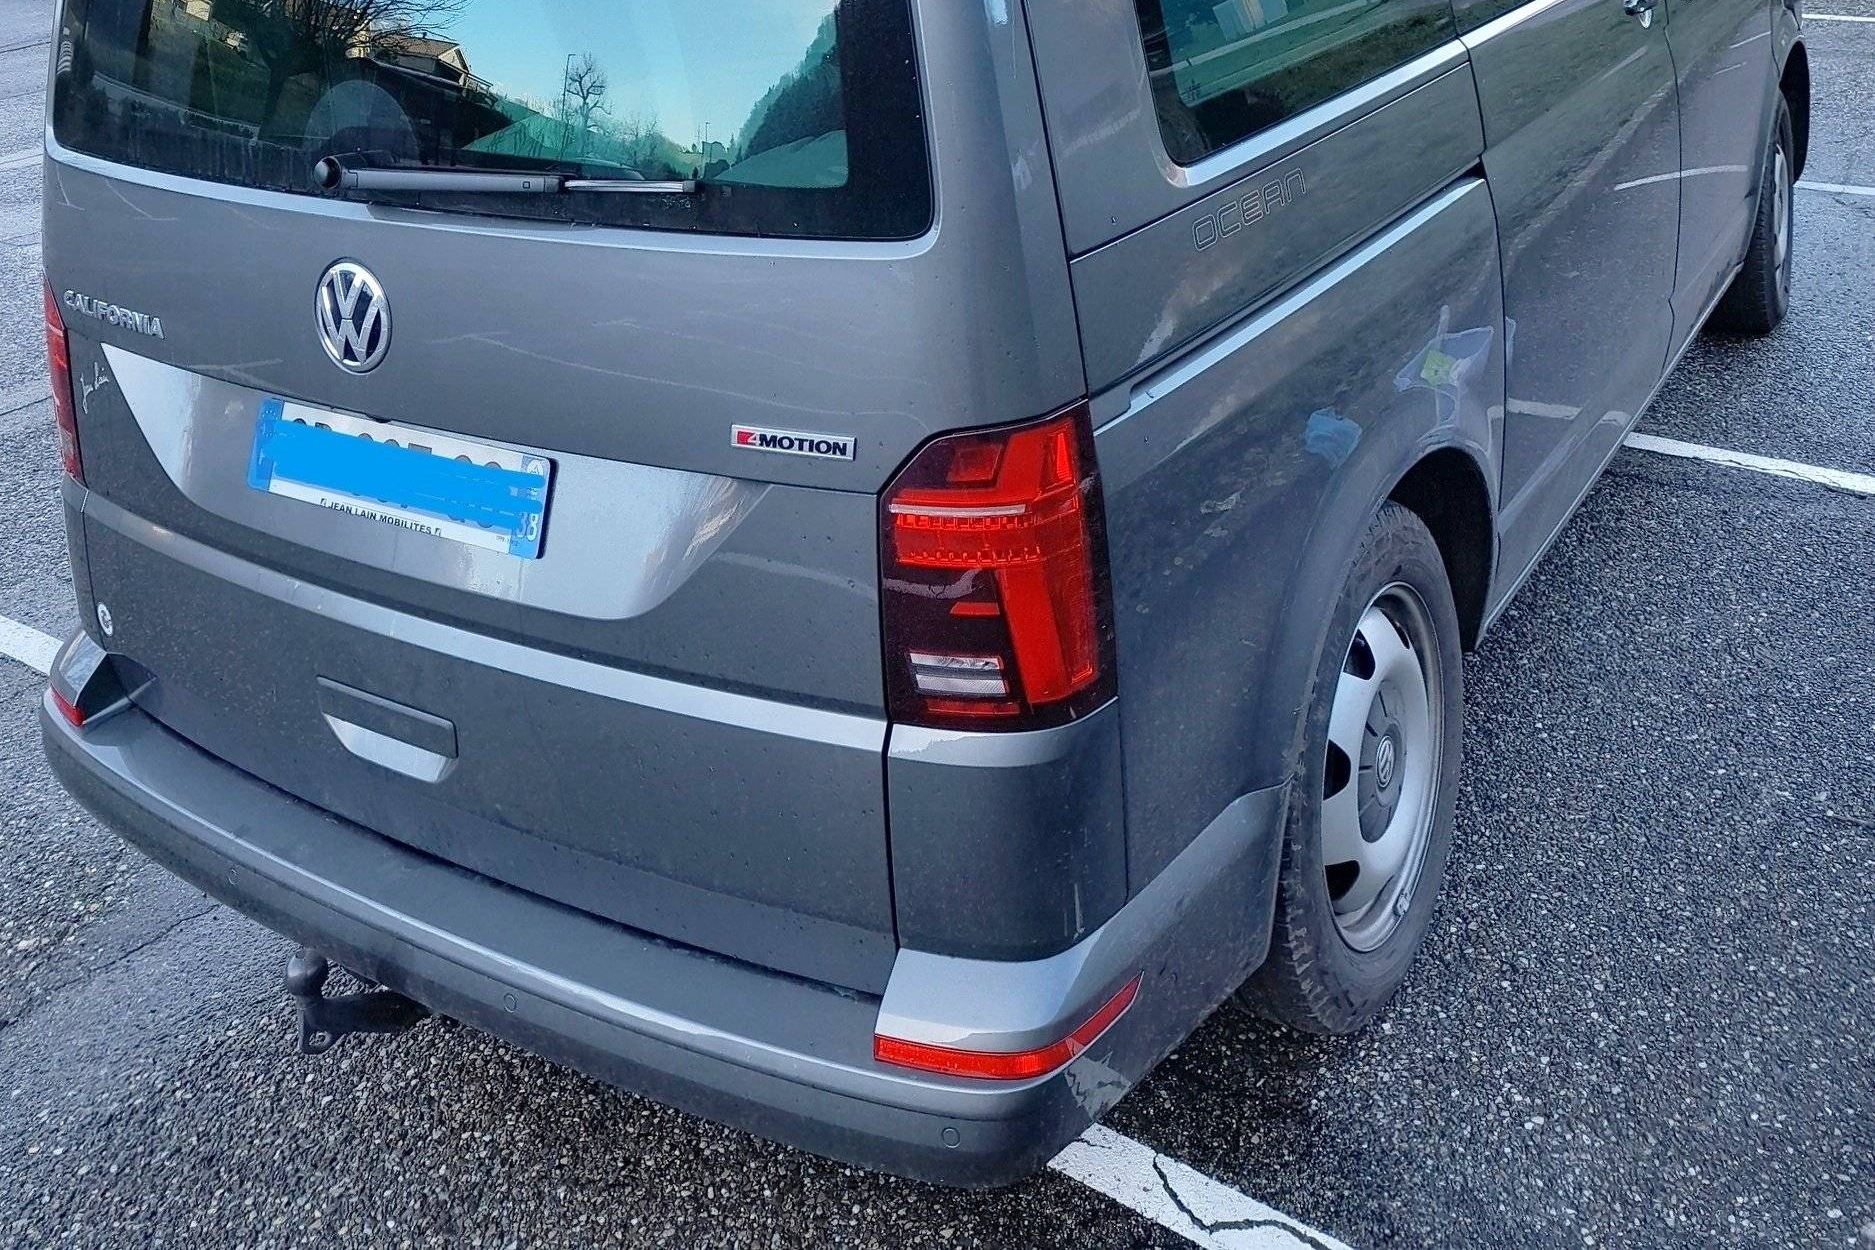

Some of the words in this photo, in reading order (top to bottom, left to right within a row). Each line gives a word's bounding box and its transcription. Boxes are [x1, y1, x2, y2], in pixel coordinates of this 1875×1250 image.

[1192, 168, 1307, 251] OCEAN
[63, 290, 165, 339] CALIFORNIA
[328, 501, 353, 514] JEAN
[354, 508, 378, 521] LAIN
